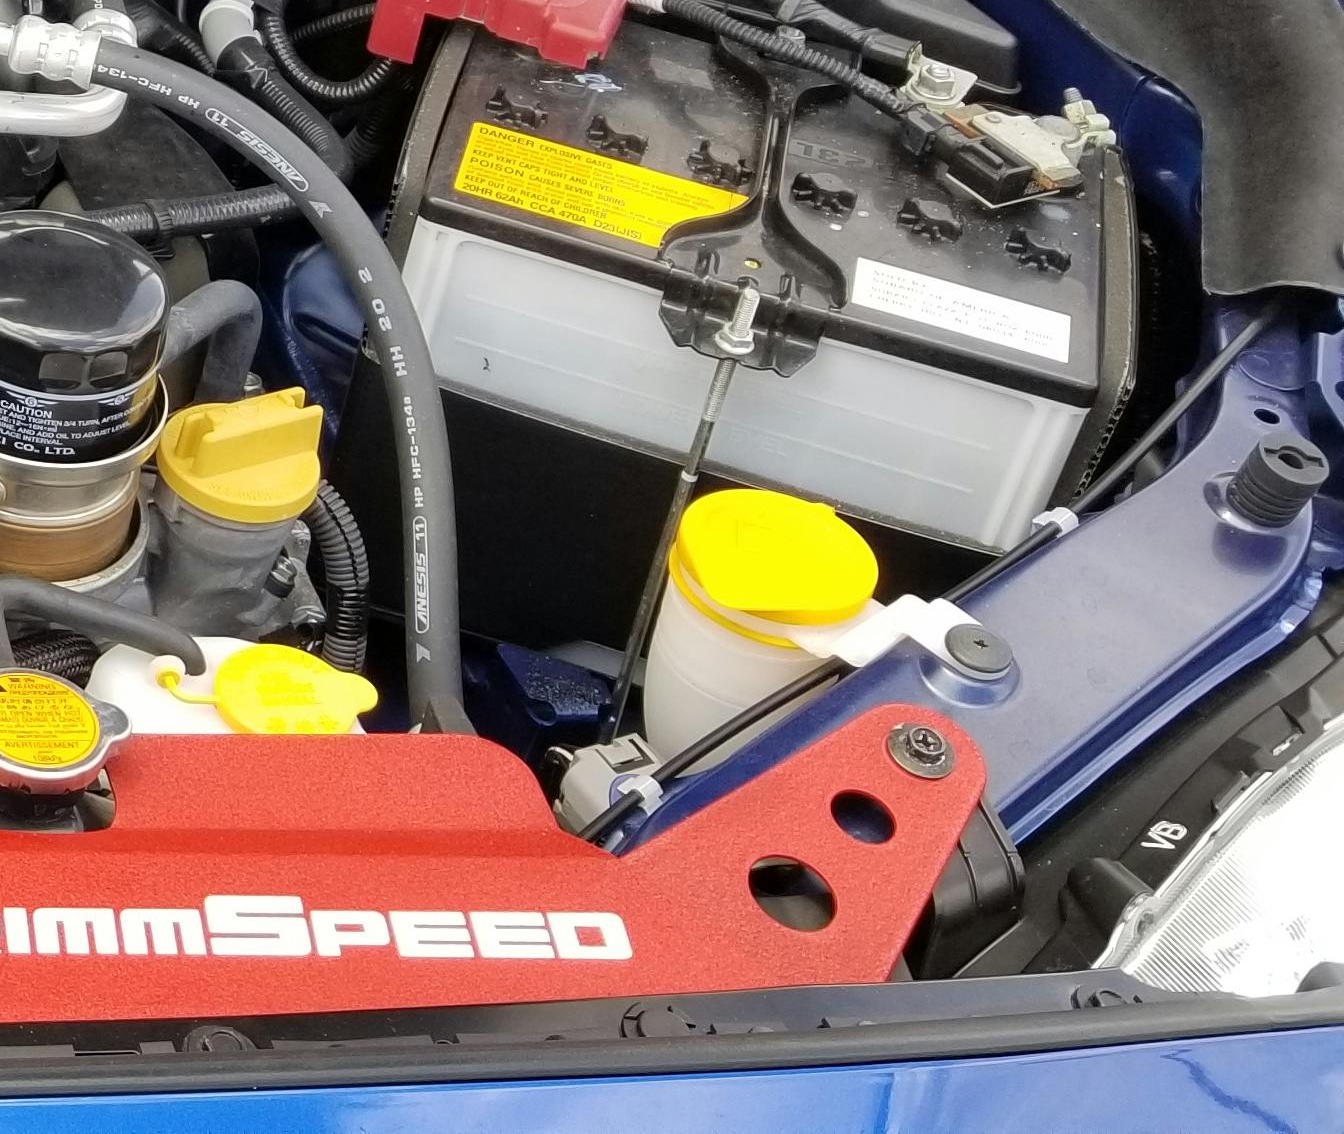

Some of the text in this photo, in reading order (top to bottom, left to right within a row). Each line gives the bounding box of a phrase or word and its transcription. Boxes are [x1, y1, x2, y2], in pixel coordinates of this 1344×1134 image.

[96, 64, 201, 110] HFC-134 HP
[478, 126, 613, 170] DANGER EXPLOSIVE GASES
[470, 156, 525, 177] POISON
[528, 174, 562, 189] CAUSES
[564, 184, 595, 197] SEVERE
[472, 149, 494, 159] KEEP
[496, 154, 517, 166] VENT
[518, 161, 541, 173] CAPS
[543, 168, 568, 182] TIGHT
[569, 176, 588, 186] AND
[462, 182, 494, 197] 20HR
[495, 191, 525, 206] 62Ah
[529, 201, 556, 215] CCA
[558, 210, 587, 224] 470A
[464, 174, 608, 220] KEEP OUT OF REACH OF CHILDREN
[389, 345, 408, 377] HH
[0, 399, 53, 419] CAUTION
[8, 411, 27, 421] AND
[27, 415, 63, 428] TIGHTEN
[101, 411, 124, 424] AFTER
[17, 426, 36, 437] AND
[36, 429, 55, 439] ADD
[55, 432, 69, 440] OIL
[70, 432, 82, 440] TO
[404, 396, 422, 480] HFC-134a
[414, 486, 424, 508] HP
[8, 683, 57, 691] WARNING
[4, 741, 80, 749] AVERTISSEMENT
[1140, 819, 1188, 850] VB
